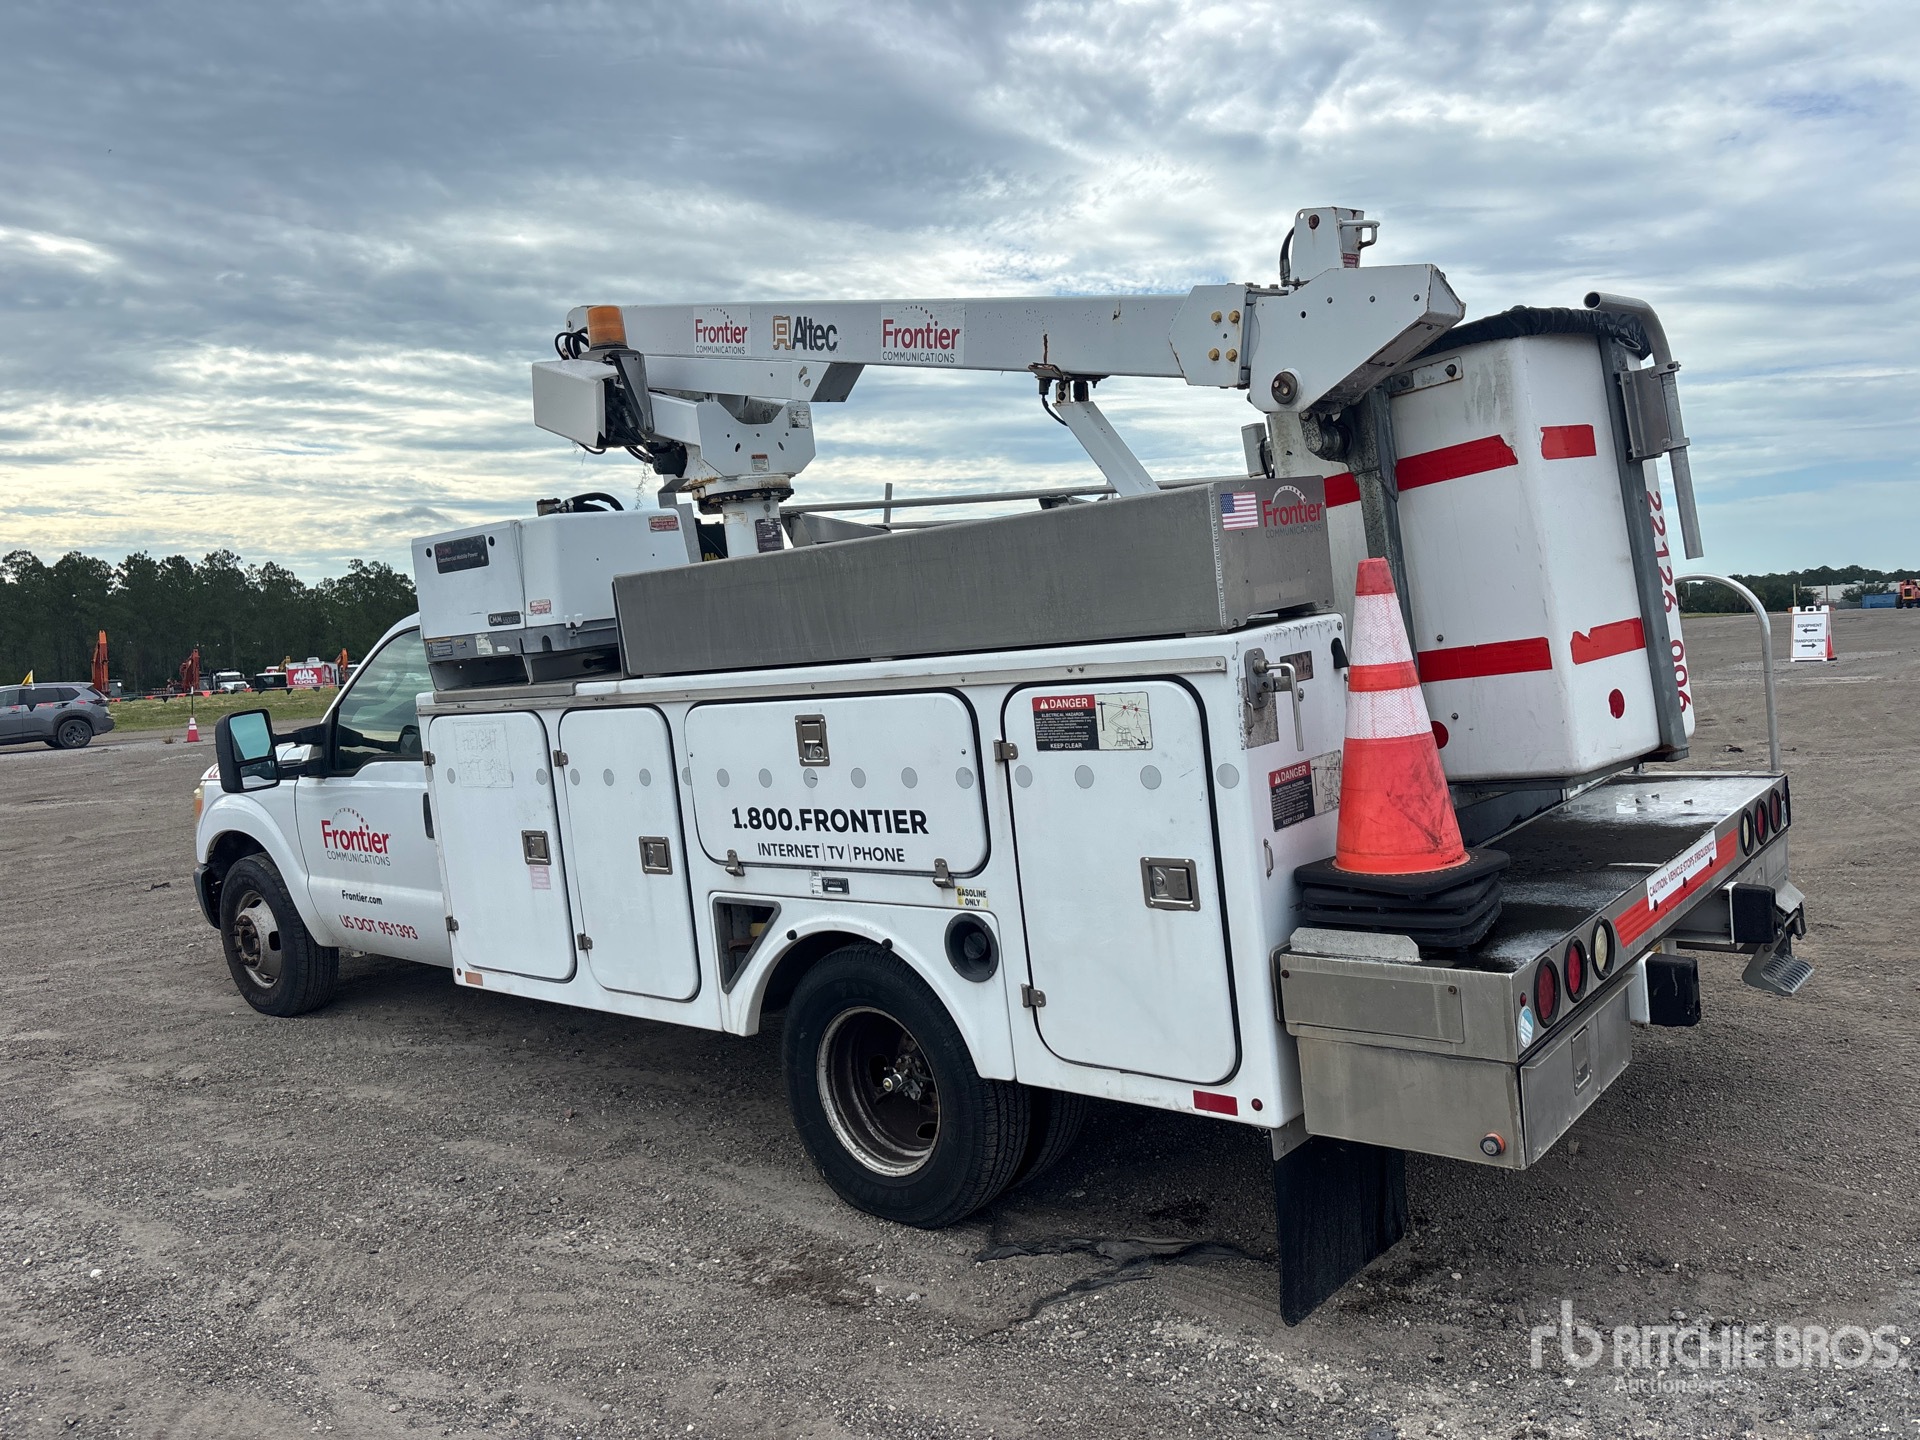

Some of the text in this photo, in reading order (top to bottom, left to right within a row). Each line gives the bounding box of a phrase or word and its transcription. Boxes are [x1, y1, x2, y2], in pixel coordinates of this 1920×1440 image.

[695, 319, 748, 344] Frontier
[792, 316, 838, 351] Altec
[882, 319, 960, 349] Frontier
[695, 345, 746, 355] COMMUNICATIONS
[882, 351, 956, 363] COMMUNICATIONS
[1262, 499, 1323, 528] Frontier
[1265, 524, 1322, 539] COMMUNICATIONS
[293, 669, 317, 680] MAC
[1049, 697, 1088, 709] DANGER
[1280, 765, 1307, 782] DANGER
[731, 806, 929, 834] 1.800.FRONTIER
[321, 820, 390, 854] Frontier
[326, 850, 391, 867] COMMUNICATIONS
[757, 842, 906, 863] INTERNET TV PHONE
[1668, 863, 1684, 882] VEHICLE
[1684, 855, 1695, 871] STOPS
[341, 889, 383, 905] Frontier.com
[956, 887, 987, 899] GASOLINE
[964, 897, 981, 907] ONLY
[338, 914, 419, 941] US DOT 951393
